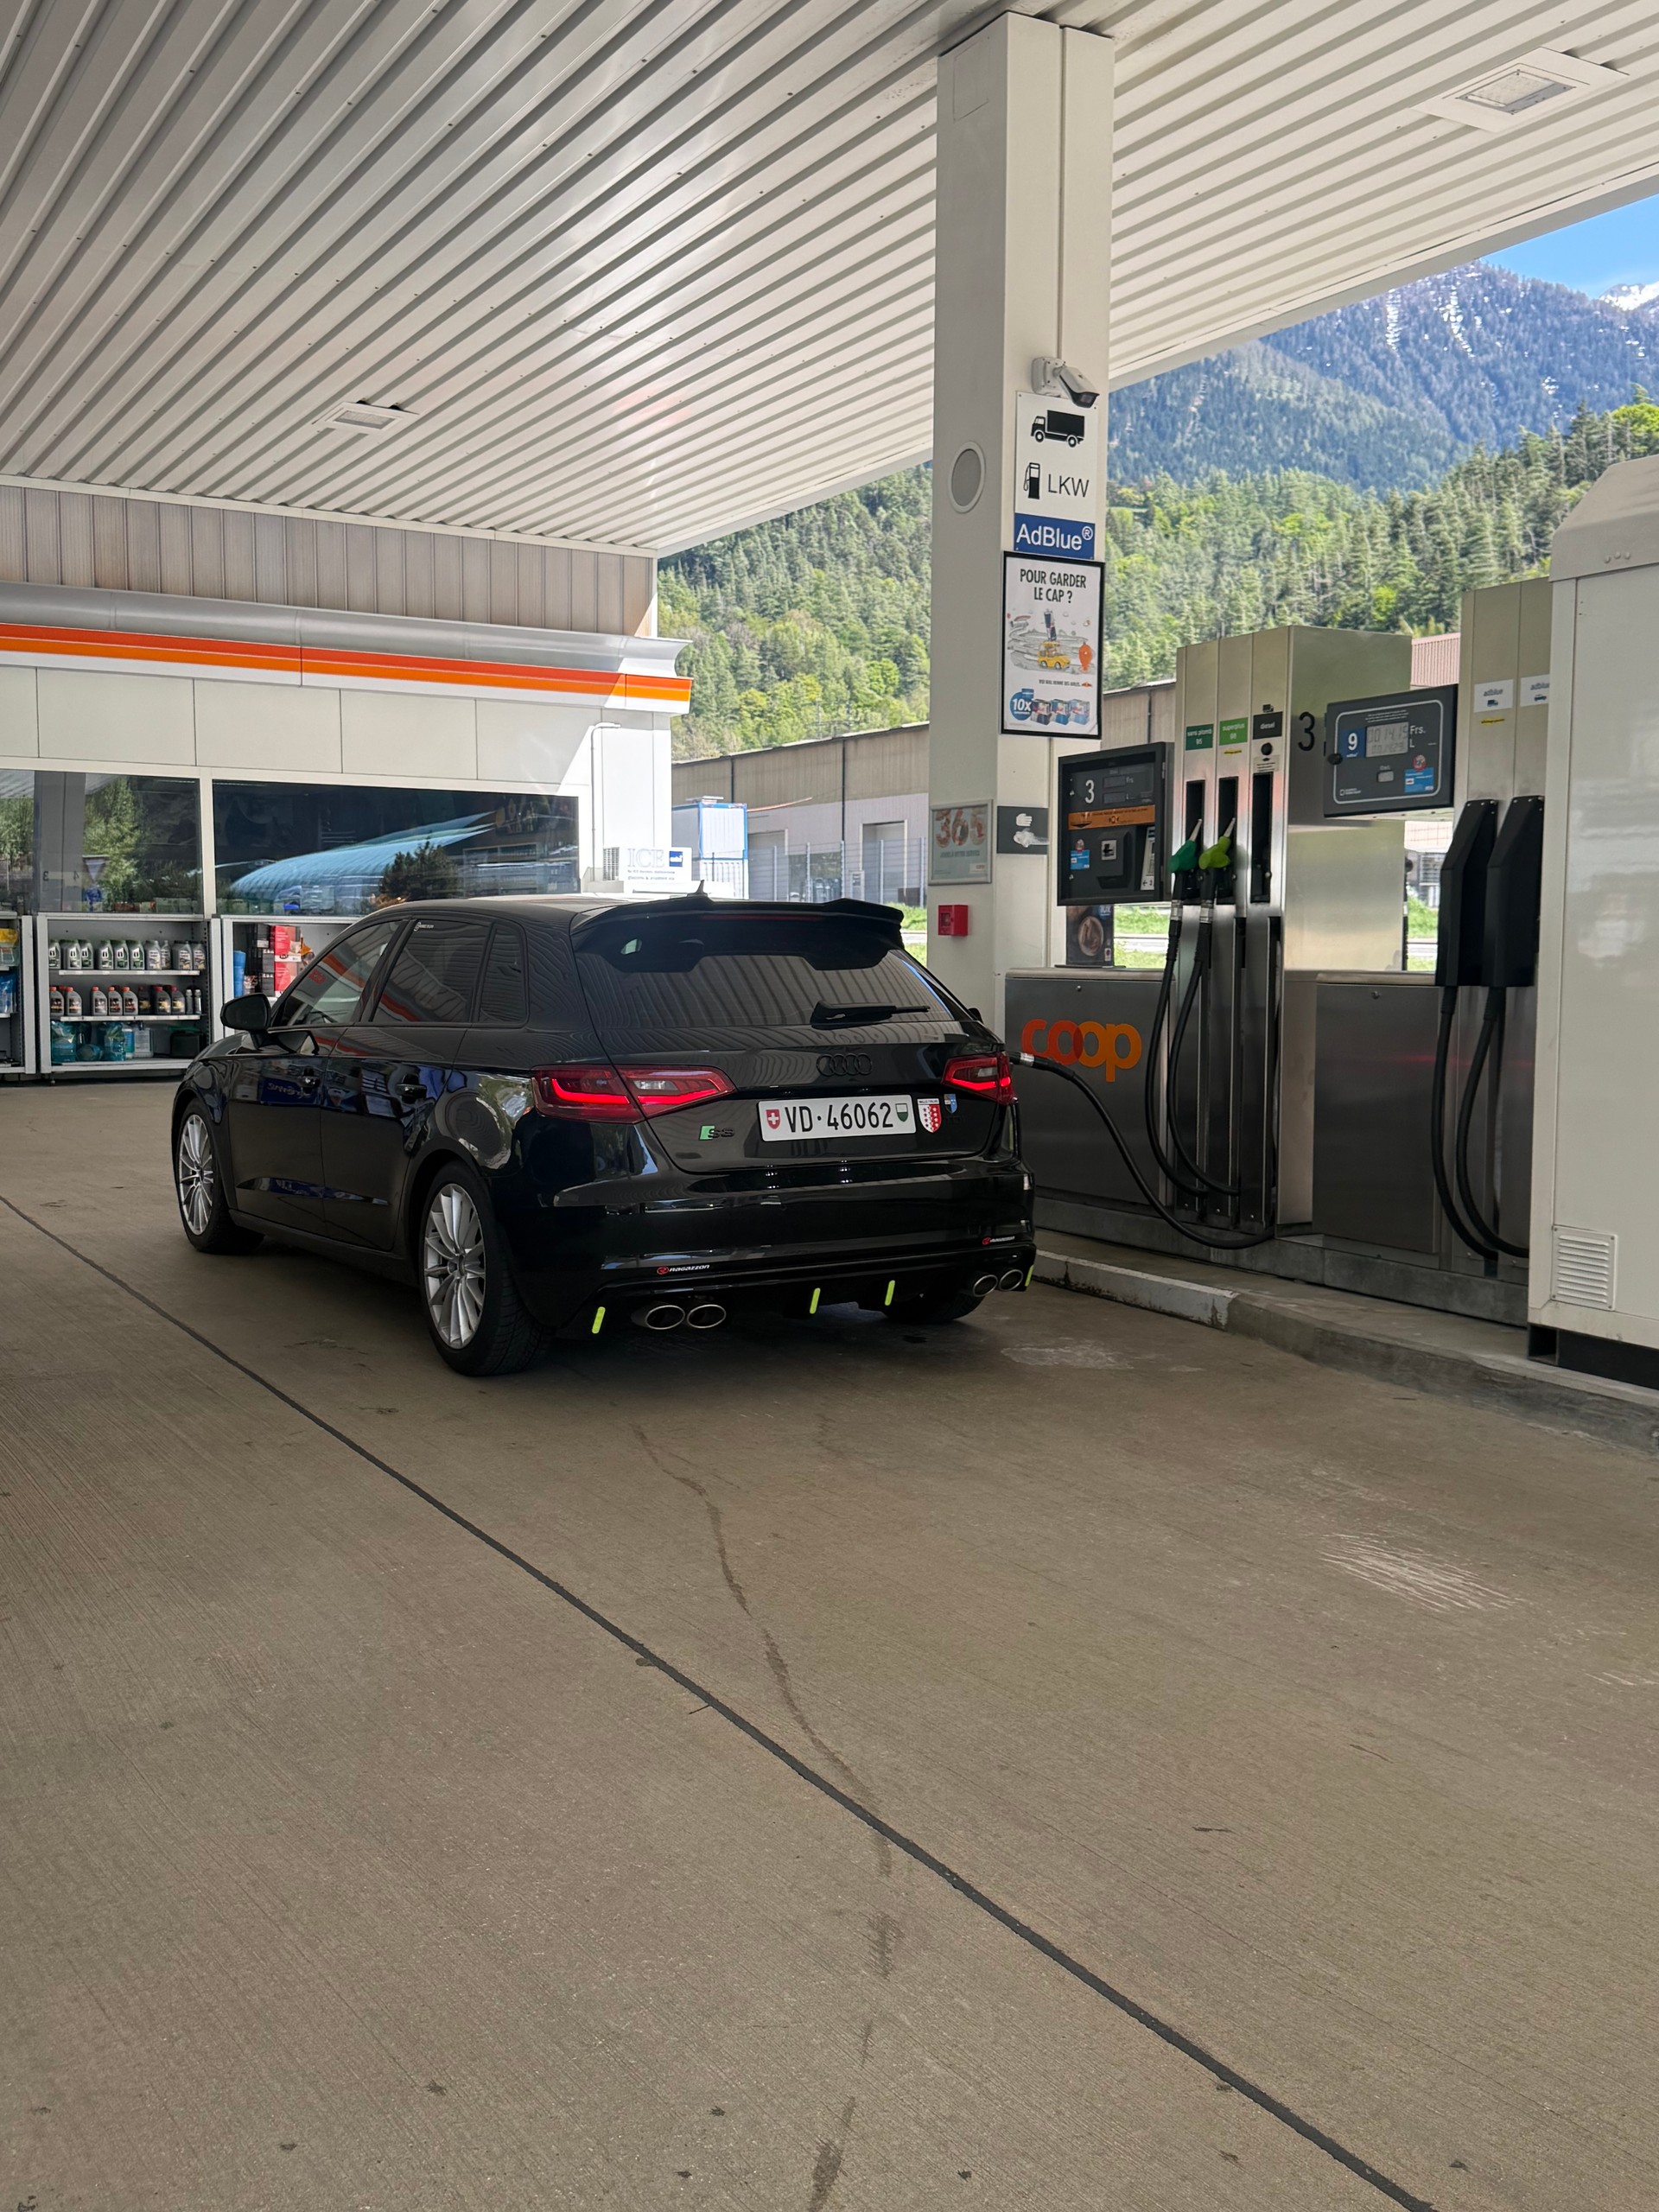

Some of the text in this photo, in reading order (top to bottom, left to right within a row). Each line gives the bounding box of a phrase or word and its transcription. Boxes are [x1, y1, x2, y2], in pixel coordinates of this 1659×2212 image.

[1047, 474, 1090, 498] LKW
[1020, 569, 1087, 588] POUR GARDER
[1033, 587, 1044, 601] LE
[1046, 588, 1065, 602] CAP
[1012, 698, 1032, 711] 10x
[1260, 721, 1275, 730] diesel
[1298, 711, 1315, 751] 3
[1347, 733, 1358, 751] 9
[1409, 739, 1415, 747] L
[1084, 779, 1095, 804] 3
[935, 807, 987, 848] 365
[627, 849, 665, 868] ICE
[1021, 1018, 1142, 1083] coop
